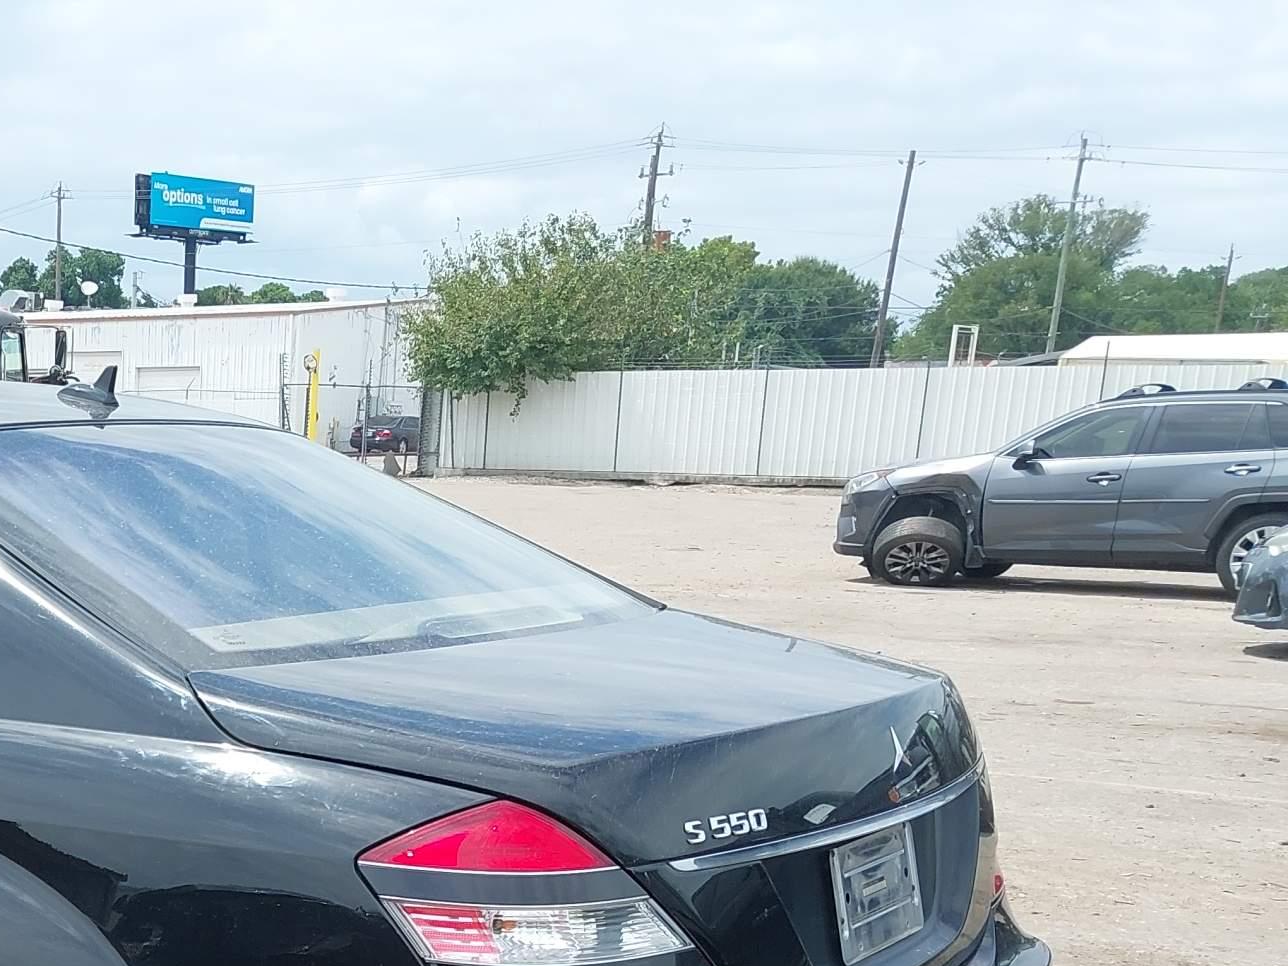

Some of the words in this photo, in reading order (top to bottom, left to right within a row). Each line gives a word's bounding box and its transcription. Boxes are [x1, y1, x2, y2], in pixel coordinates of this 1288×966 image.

[163, 188, 204, 206] options
[213, 198, 229, 206] small
[213, 204, 226, 215] lung
[226, 207, 246, 216] cancer
[684, 820, 706, 844] S
[709, 808, 768, 839] 550
